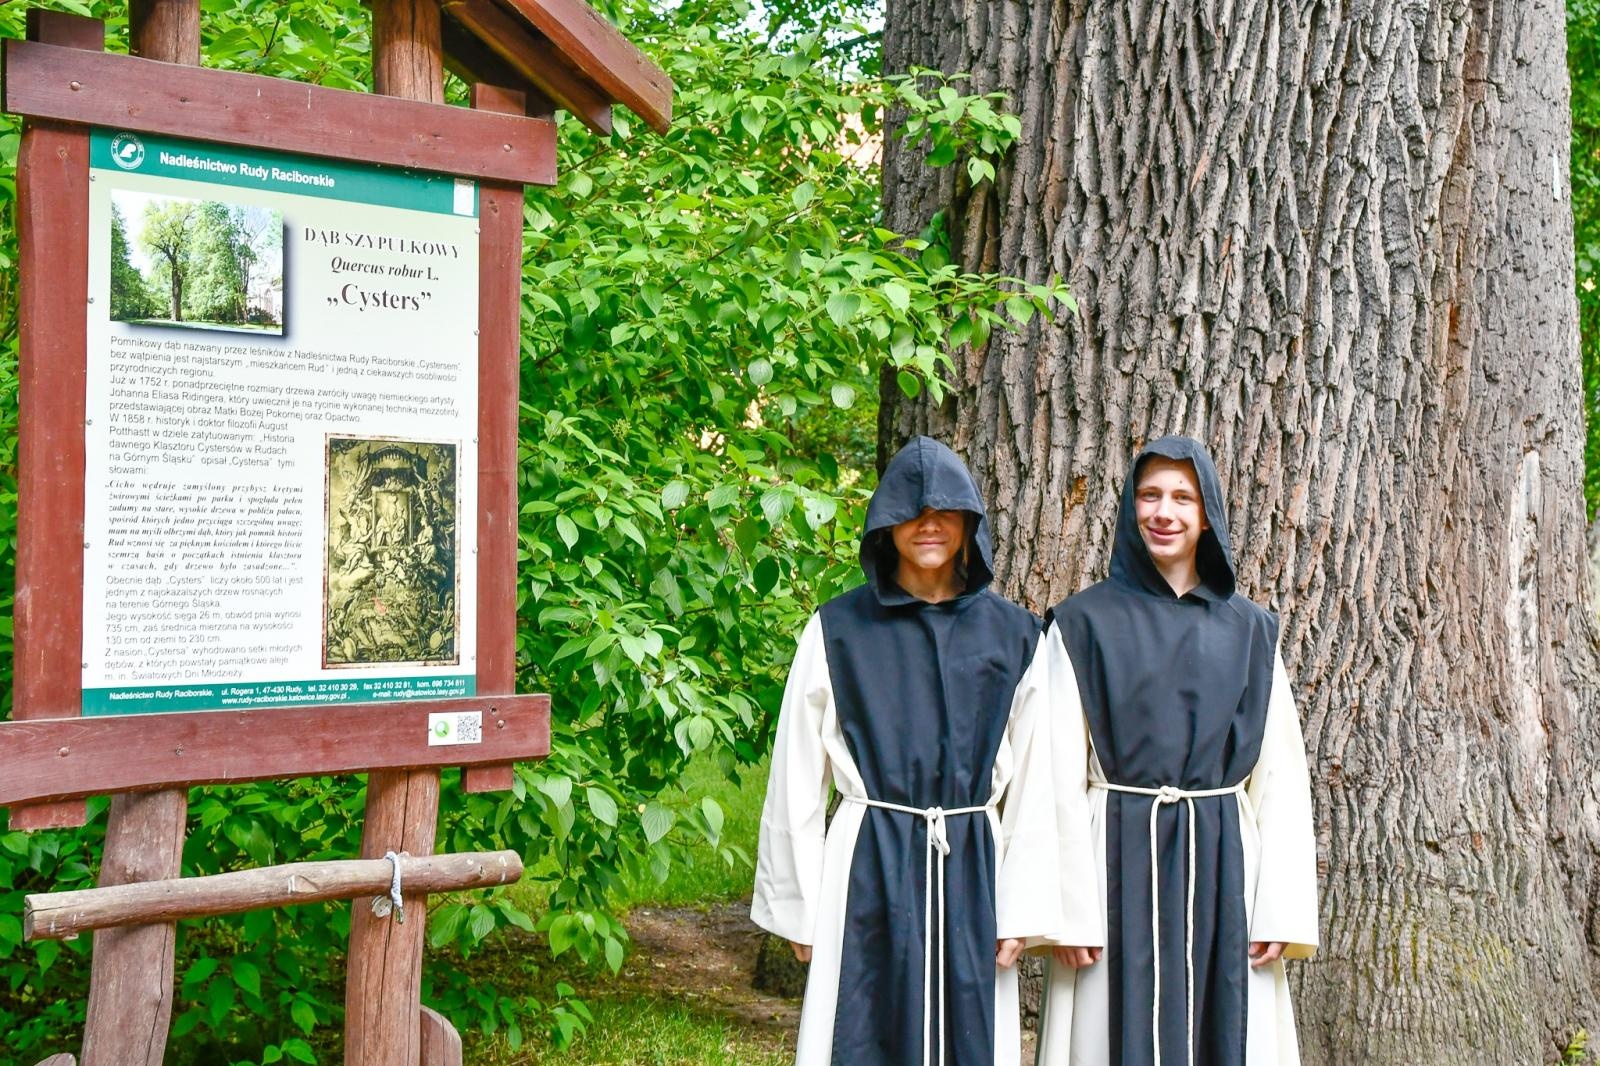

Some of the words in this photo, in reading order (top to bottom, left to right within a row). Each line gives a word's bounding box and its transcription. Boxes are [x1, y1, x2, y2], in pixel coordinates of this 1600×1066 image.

[160, 152, 237, 173] Nadleśnictwo
[240, 163, 269, 181] Rudy
[272, 168, 335, 187] Raciborskie
[305, 227, 340, 247] DĄB
[331, 257, 384, 274] Quercus
[388, 264, 423, 278] robur
[427, 267, 439, 280] L.
[110, 336, 162, 350] Pomnikowy
[164, 340, 181, 352] dąb
[183, 343, 222, 355] nazwany
[224, 346, 247, 355] przez
[249, 347, 285, 357] leśników
[294, 350, 347, 362] Nadleśnictwa
[349, 353, 369, 366] Rudy
[371, 355, 415, 367] Raciborskie
[110, 349, 127, 359] bez
[129, 352, 171, 362] wątpienia
[173, 355, 189, 364] jest
[191, 355, 243, 368] najstarszym
[336, 365, 358, 376] jedną
[366, 368, 414, 380] ciekawszych
[415, 372, 457, 382] osobliwości
[110, 364, 178, 376] przyrodniczych
[110, 374, 126, 385] Już
[140, 376, 162, 387] 1752
[172, 380, 245, 392] ponadprzeciętne
[247, 385, 283, 396] rozmiary
[285, 386, 315, 396] drzewa
[317, 389, 349, 400] zwróciły
[351, 392, 377, 401] uwagę
[379, 393, 428, 404] niemieckiego
[430, 396, 454, 406] artysty
[110, 387, 149, 399] Johanna
[152, 389, 179, 400] Eliasa
[228, 394, 250, 406] który
[252, 398, 290, 406] uwiecznił
[314, 401, 341, 410] rycinie
[343, 402, 384, 413] wykonanej
[386, 404, 418, 415] techniką
[109, 402, 184, 415] przedstawiającej
[187, 405, 212, 415] obraz
[214, 406, 238, 416] Matki
[239, 407, 264, 419] Bożej
[266, 408, 303, 421] Pokornej
[304, 413, 323, 421] oraz
[109, 413, 120, 422] W
[123, 413, 145, 424] 1858
[156, 416, 190, 428] historyk
[198, 418, 225, 428] doktor
[227, 419, 257, 429] filozofii
[258, 420, 288, 432] August
[162, 429, 189, 438] dziele
[109, 439, 151, 451] dawnego
[153, 440, 195, 451] Klasztoru
[197, 442, 242, 454] Cystersów
[254, 444, 287, 455] Rudach
[123, 452, 160, 464] Górnym
[201, 456, 227, 466] opisał
[277, 459, 295, 469] tymi
